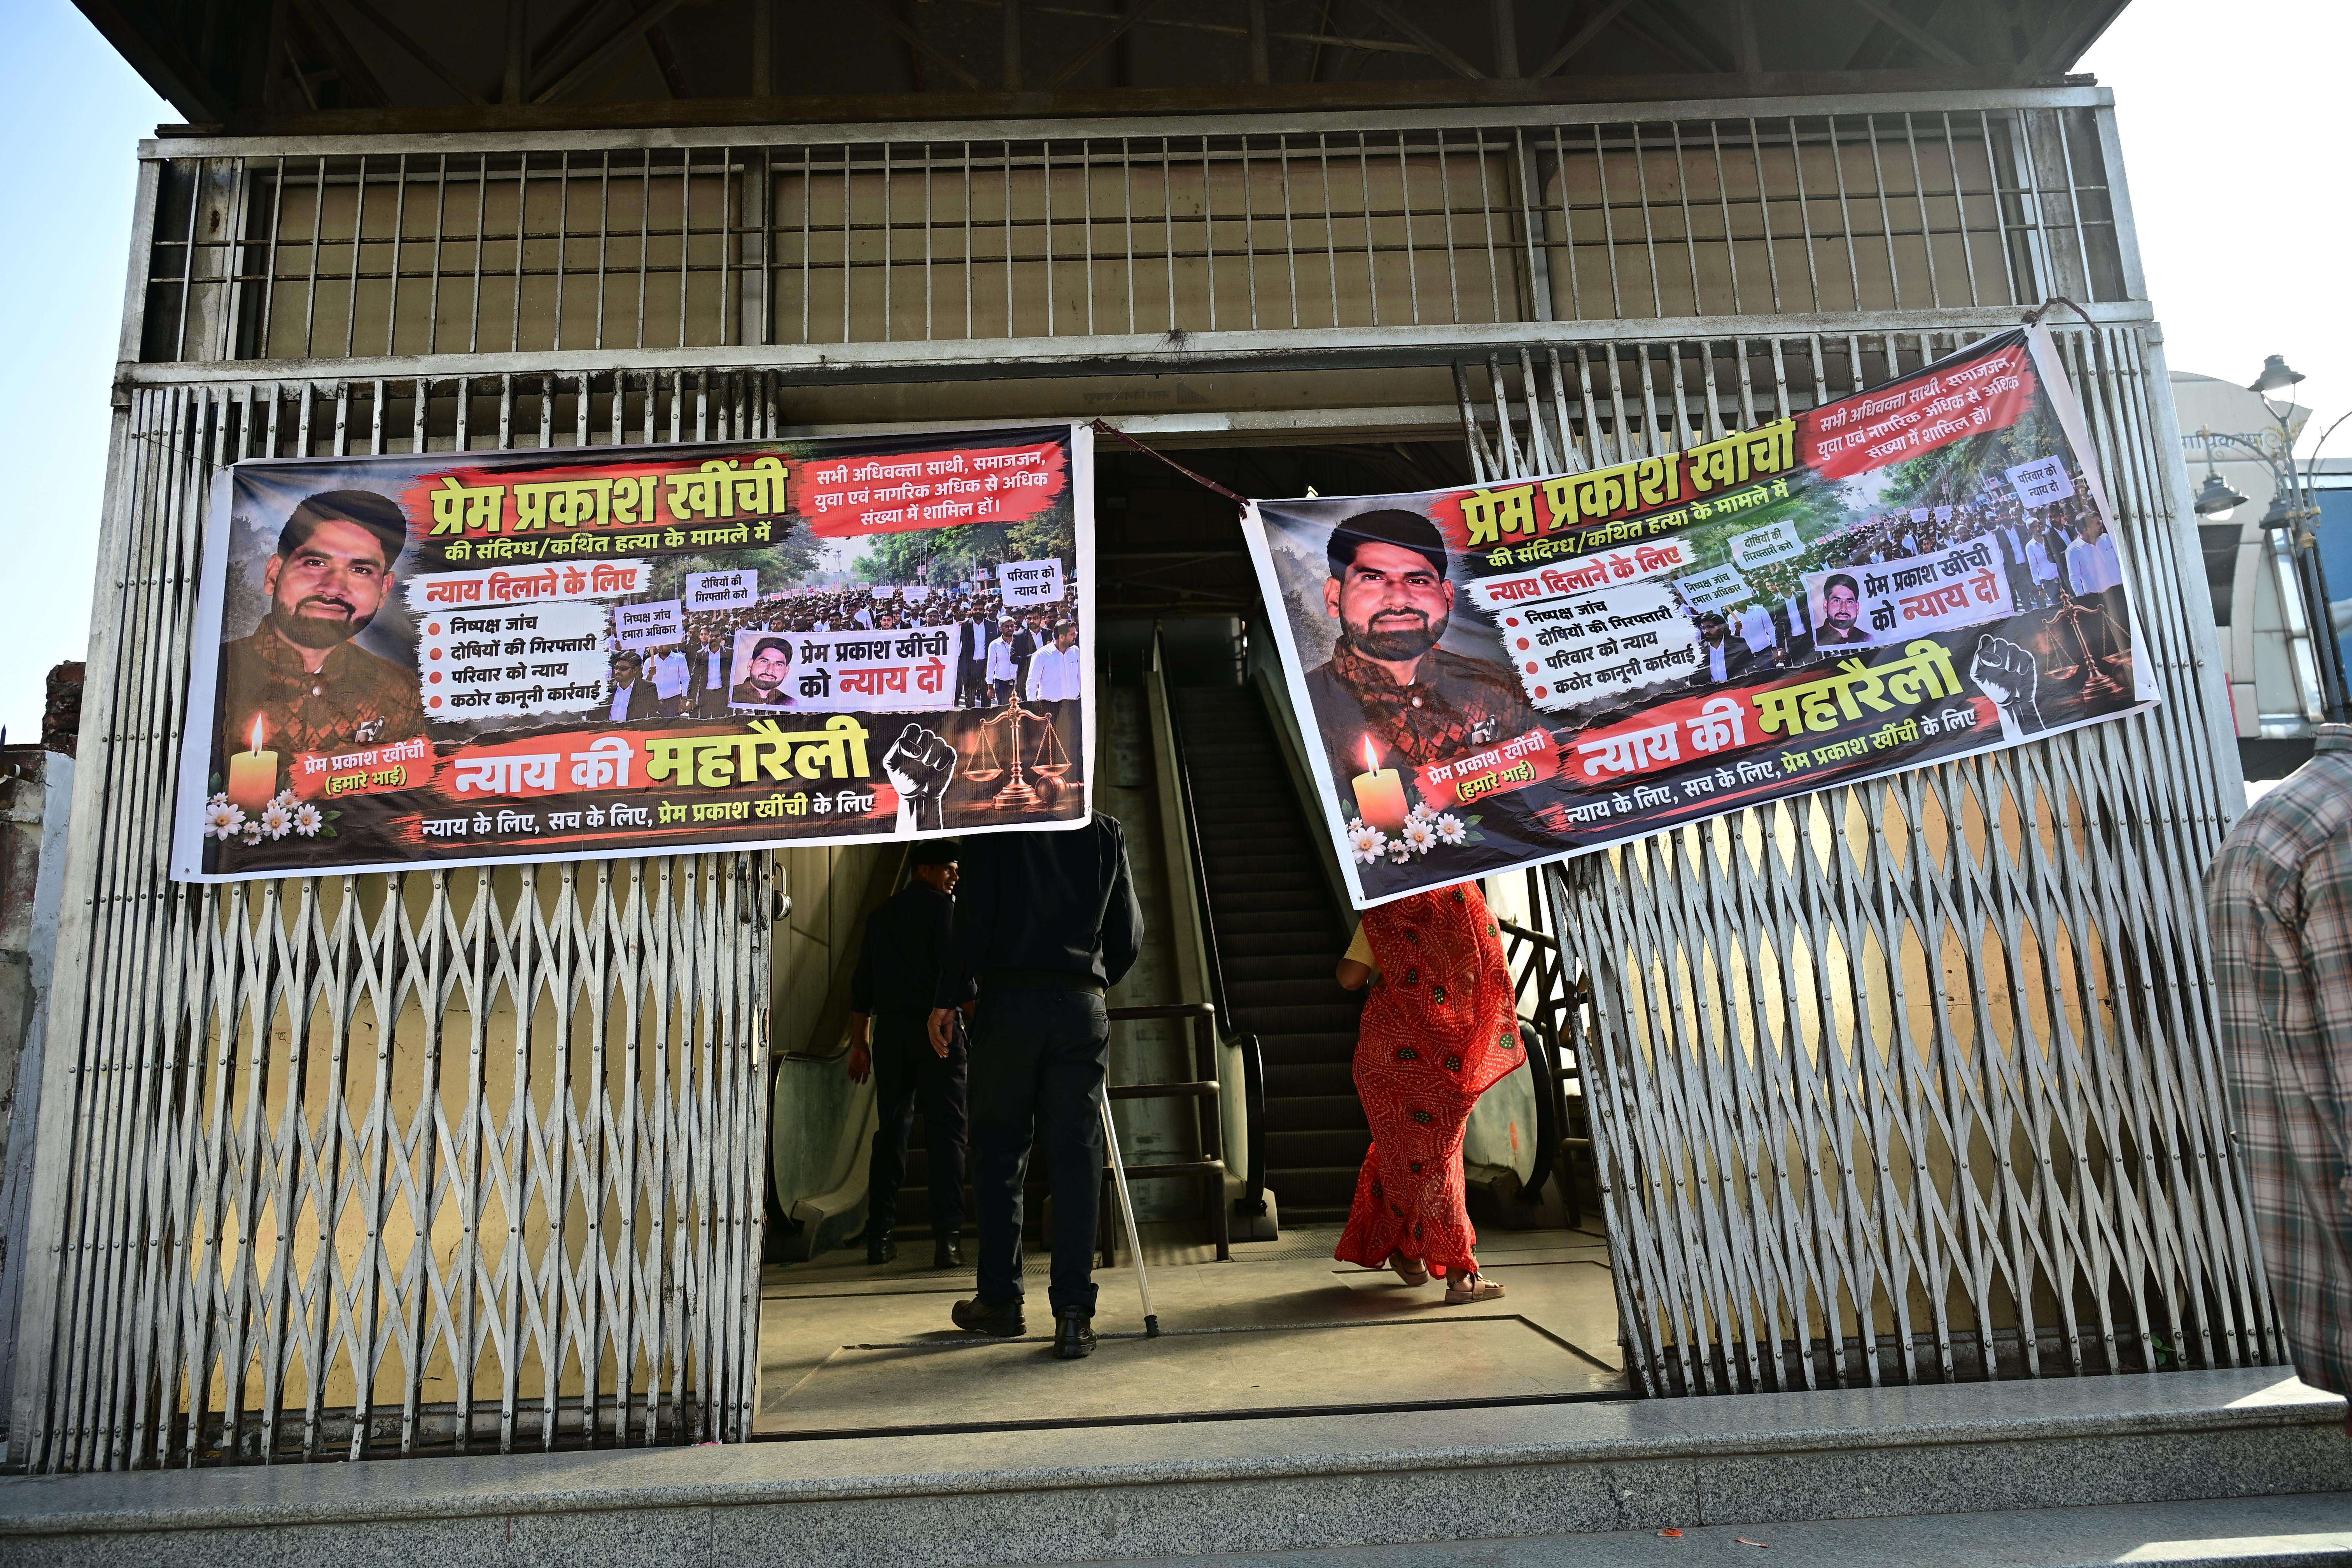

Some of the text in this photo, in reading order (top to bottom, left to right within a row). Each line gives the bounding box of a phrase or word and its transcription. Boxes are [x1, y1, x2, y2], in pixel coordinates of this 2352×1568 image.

[1821, 357, 2016, 431] सभी अधिवक्ता साथी, समाजजन,
[1818, 376, 2018, 460] युवा एवं नागरिक अधिक से अधिक
[1865, 406, 1990, 457] संख्या में शामिल हों।
[817, 452, 1045, 484] सभी अधिवक्ता साथी, समाजजन,
[2018, 464, 2057, 483] परिवार को
[430, 458, 788, 534] प्रेम प्रकाश खींची
[815, 471, 1048, 512] युवा एवं नागरिक अधिक से अधिक
[1542, 453, 1680, 530] प्रकाश
[2028, 480, 2059, 495] न्याय दो
[861, 497, 999, 525] संख्या में शामिल हों।
[1486, 548, 1513, 566] की
[1646, 510, 1687, 533] हत्या
[1690, 502, 1712, 519] के
[1714, 485, 1769, 513] मामले
[1771, 479, 1788, 497] में
[445, 541, 472, 560] की
[615, 534, 659, 551] हत्या
[665, 528, 685, 546] के
[691, 523, 749, 545] मामले
[754, 522, 771, 541] में
[1743, 541, 1793, 562] गिरफ्तारी करो
[1744, 528, 1781, 548] दोषियों की
[427, 565, 636, 602] न्याय दिलाने के लिए
[702, 575, 742, 588] दोषियों की
[1007, 566, 1054, 581] परिवार को
[1486, 547, 1682, 600] न्याय दिलाने के लिए
[1684, 574, 1730, 593] निष्पक्ष जांच
[1864, 541, 1992, 598] प्रेम प्रकाश खींची
[696, 588, 747, 602] गिरफ्तारी करो
[1014, 582, 1050, 595] न्याय दो
[1690, 584, 1742, 606] हमारा अधिकार
[1870, 569, 1999, 631] को न्याय दो
[450, 614, 538, 634] निष्पक्ष जांच
[624, 609, 670, 625] निष्पक्ष जांच
[1525, 601, 1607, 623] निष्पक्ष जांच
[1536, 606, 1673, 646] दोषियों की गिरफ्तारी
[451, 634, 596, 660] दोषियों की गिरफ्तारी
[622, 625, 676, 640] हमारा अधिकार
[801, 631, 948, 663] प्रेम प्रकाश खींची
[1545, 632, 1657, 669] परिवार को न्याय
[452, 662, 568, 683] परिवार को न्याय
[799, 657, 945, 697] को न्याय दो
[1554, 644, 1695, 693] कठोर कानूनी कार्रवाई
[451, 681, 600, 708] कठोर कानूनी कार्रवाई
[1577, 640, 1963, 776] न्याय की महारैली
[304, 740, 424, 774] प्रेम प्रकाश खींची
[455, 716, 870, 793] न्याय की महारैली
[1428, 732, 1545, 785] प्रेम प्रकाश खींची
[1565, 707, 1976, 822] न्याय के लिए, सच के लिए, प्रेम प्रकाश खींची के लिए
[326, 765, 405, 796] (हमारे भाई)
[1456, 760, 1534, 802] (हमारे भाई)
[422, 791, 874, 836] न्याय के लिए, सच के लिए, प्रेम प्रकाश खींची के लिए
